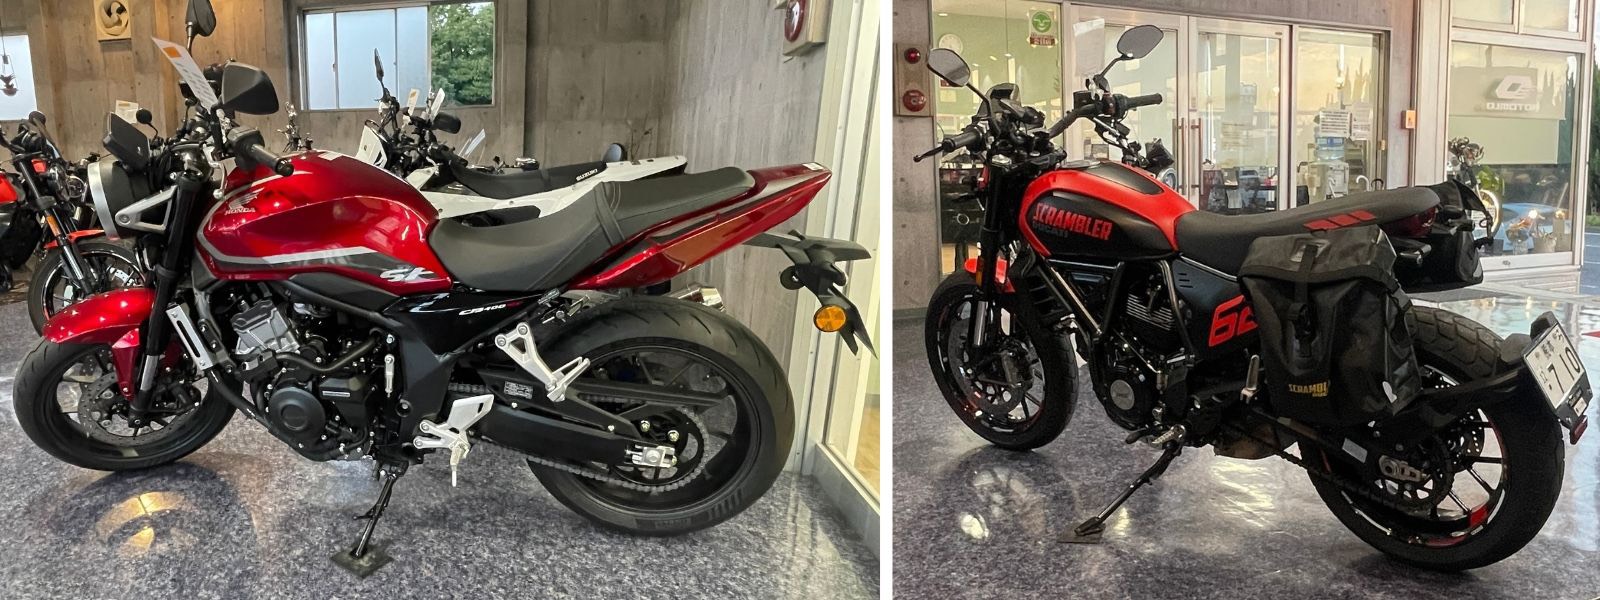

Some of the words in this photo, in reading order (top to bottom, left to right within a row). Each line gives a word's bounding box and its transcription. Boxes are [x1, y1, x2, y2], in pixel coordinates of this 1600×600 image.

[576, 168, 598, 181] SUZUKI
[224, 207, 256, 216] HONDA
[1033, 202, 1112, 240] SCRAMBLER
